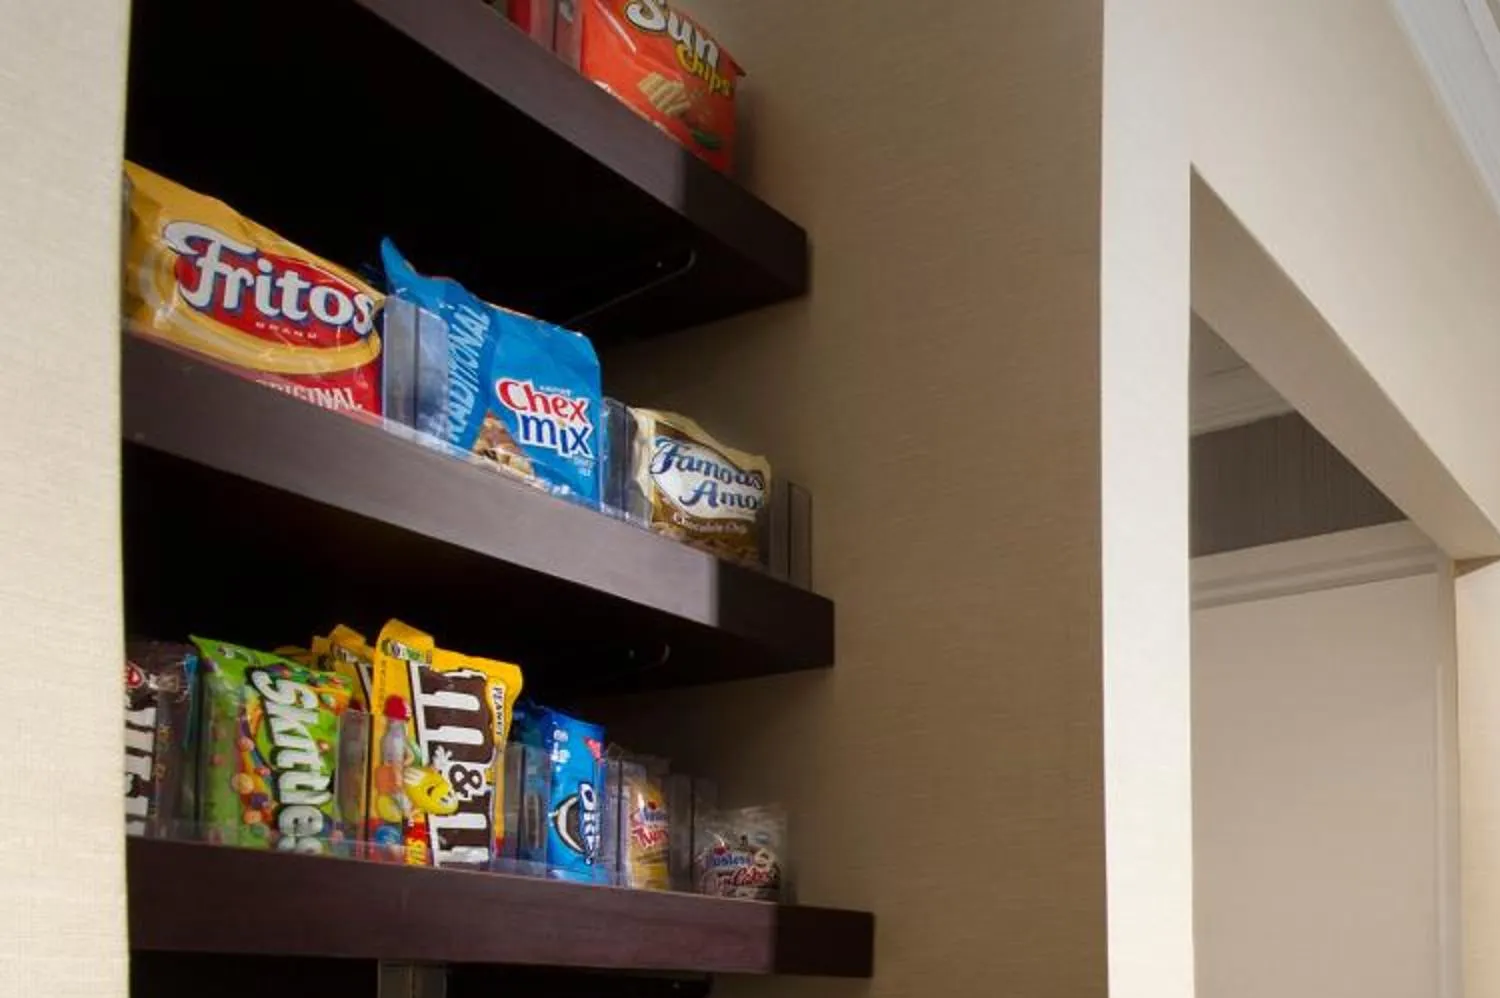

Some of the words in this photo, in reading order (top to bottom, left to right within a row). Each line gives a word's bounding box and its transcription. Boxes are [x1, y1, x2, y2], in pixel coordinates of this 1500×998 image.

[163, 219, 376, 338] Fritos
[498, 380, 588, 424] Chex
[650, 435, 766, 491] Famous
